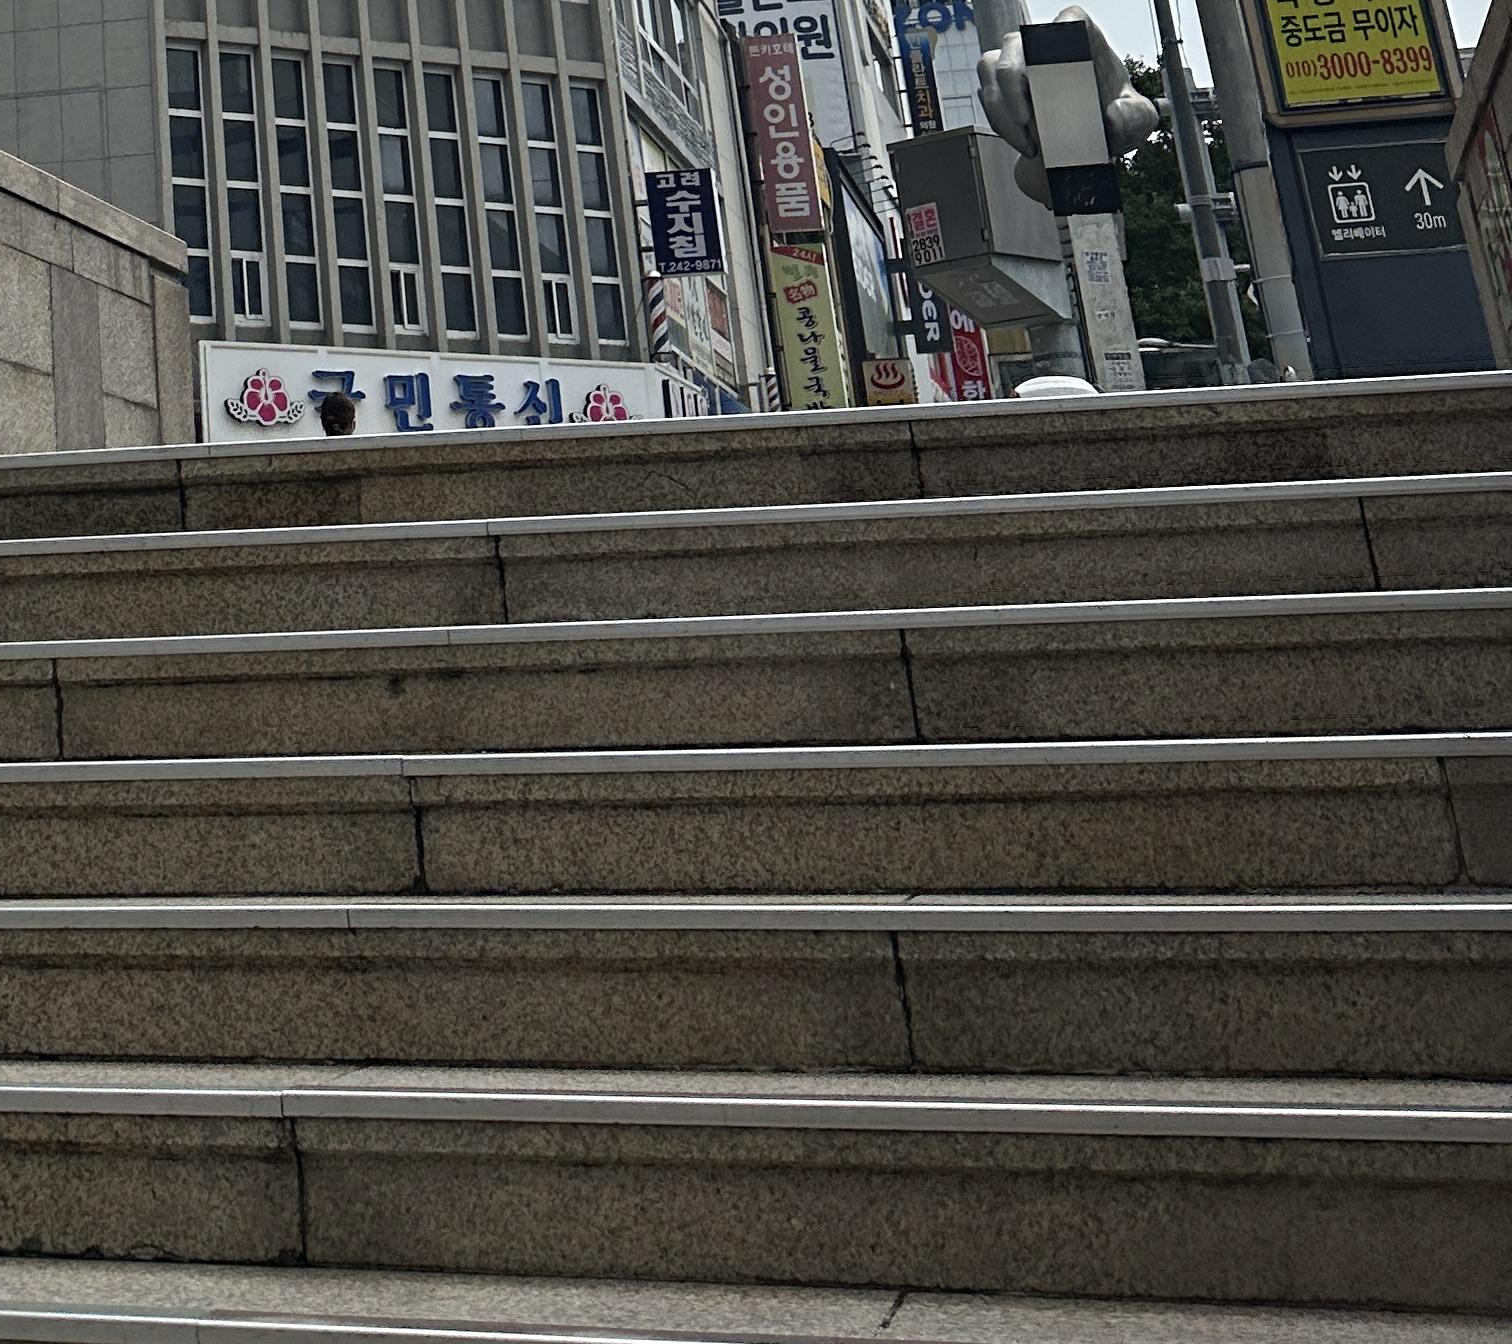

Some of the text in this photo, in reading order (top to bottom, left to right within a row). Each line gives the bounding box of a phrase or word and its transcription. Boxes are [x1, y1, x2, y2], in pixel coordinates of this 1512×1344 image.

[1281, 4, 1419, 48] 중도금 무이자
[758, 65, 811, 218] 성인용품
[656, 171, 701, 189] 고려
[665, 190, 707, 259] 수지침
[1414, 212, 1447, 230] 30m
[912, 234, 941, 253] 2839
[915, 248, 944, 265] 9011
